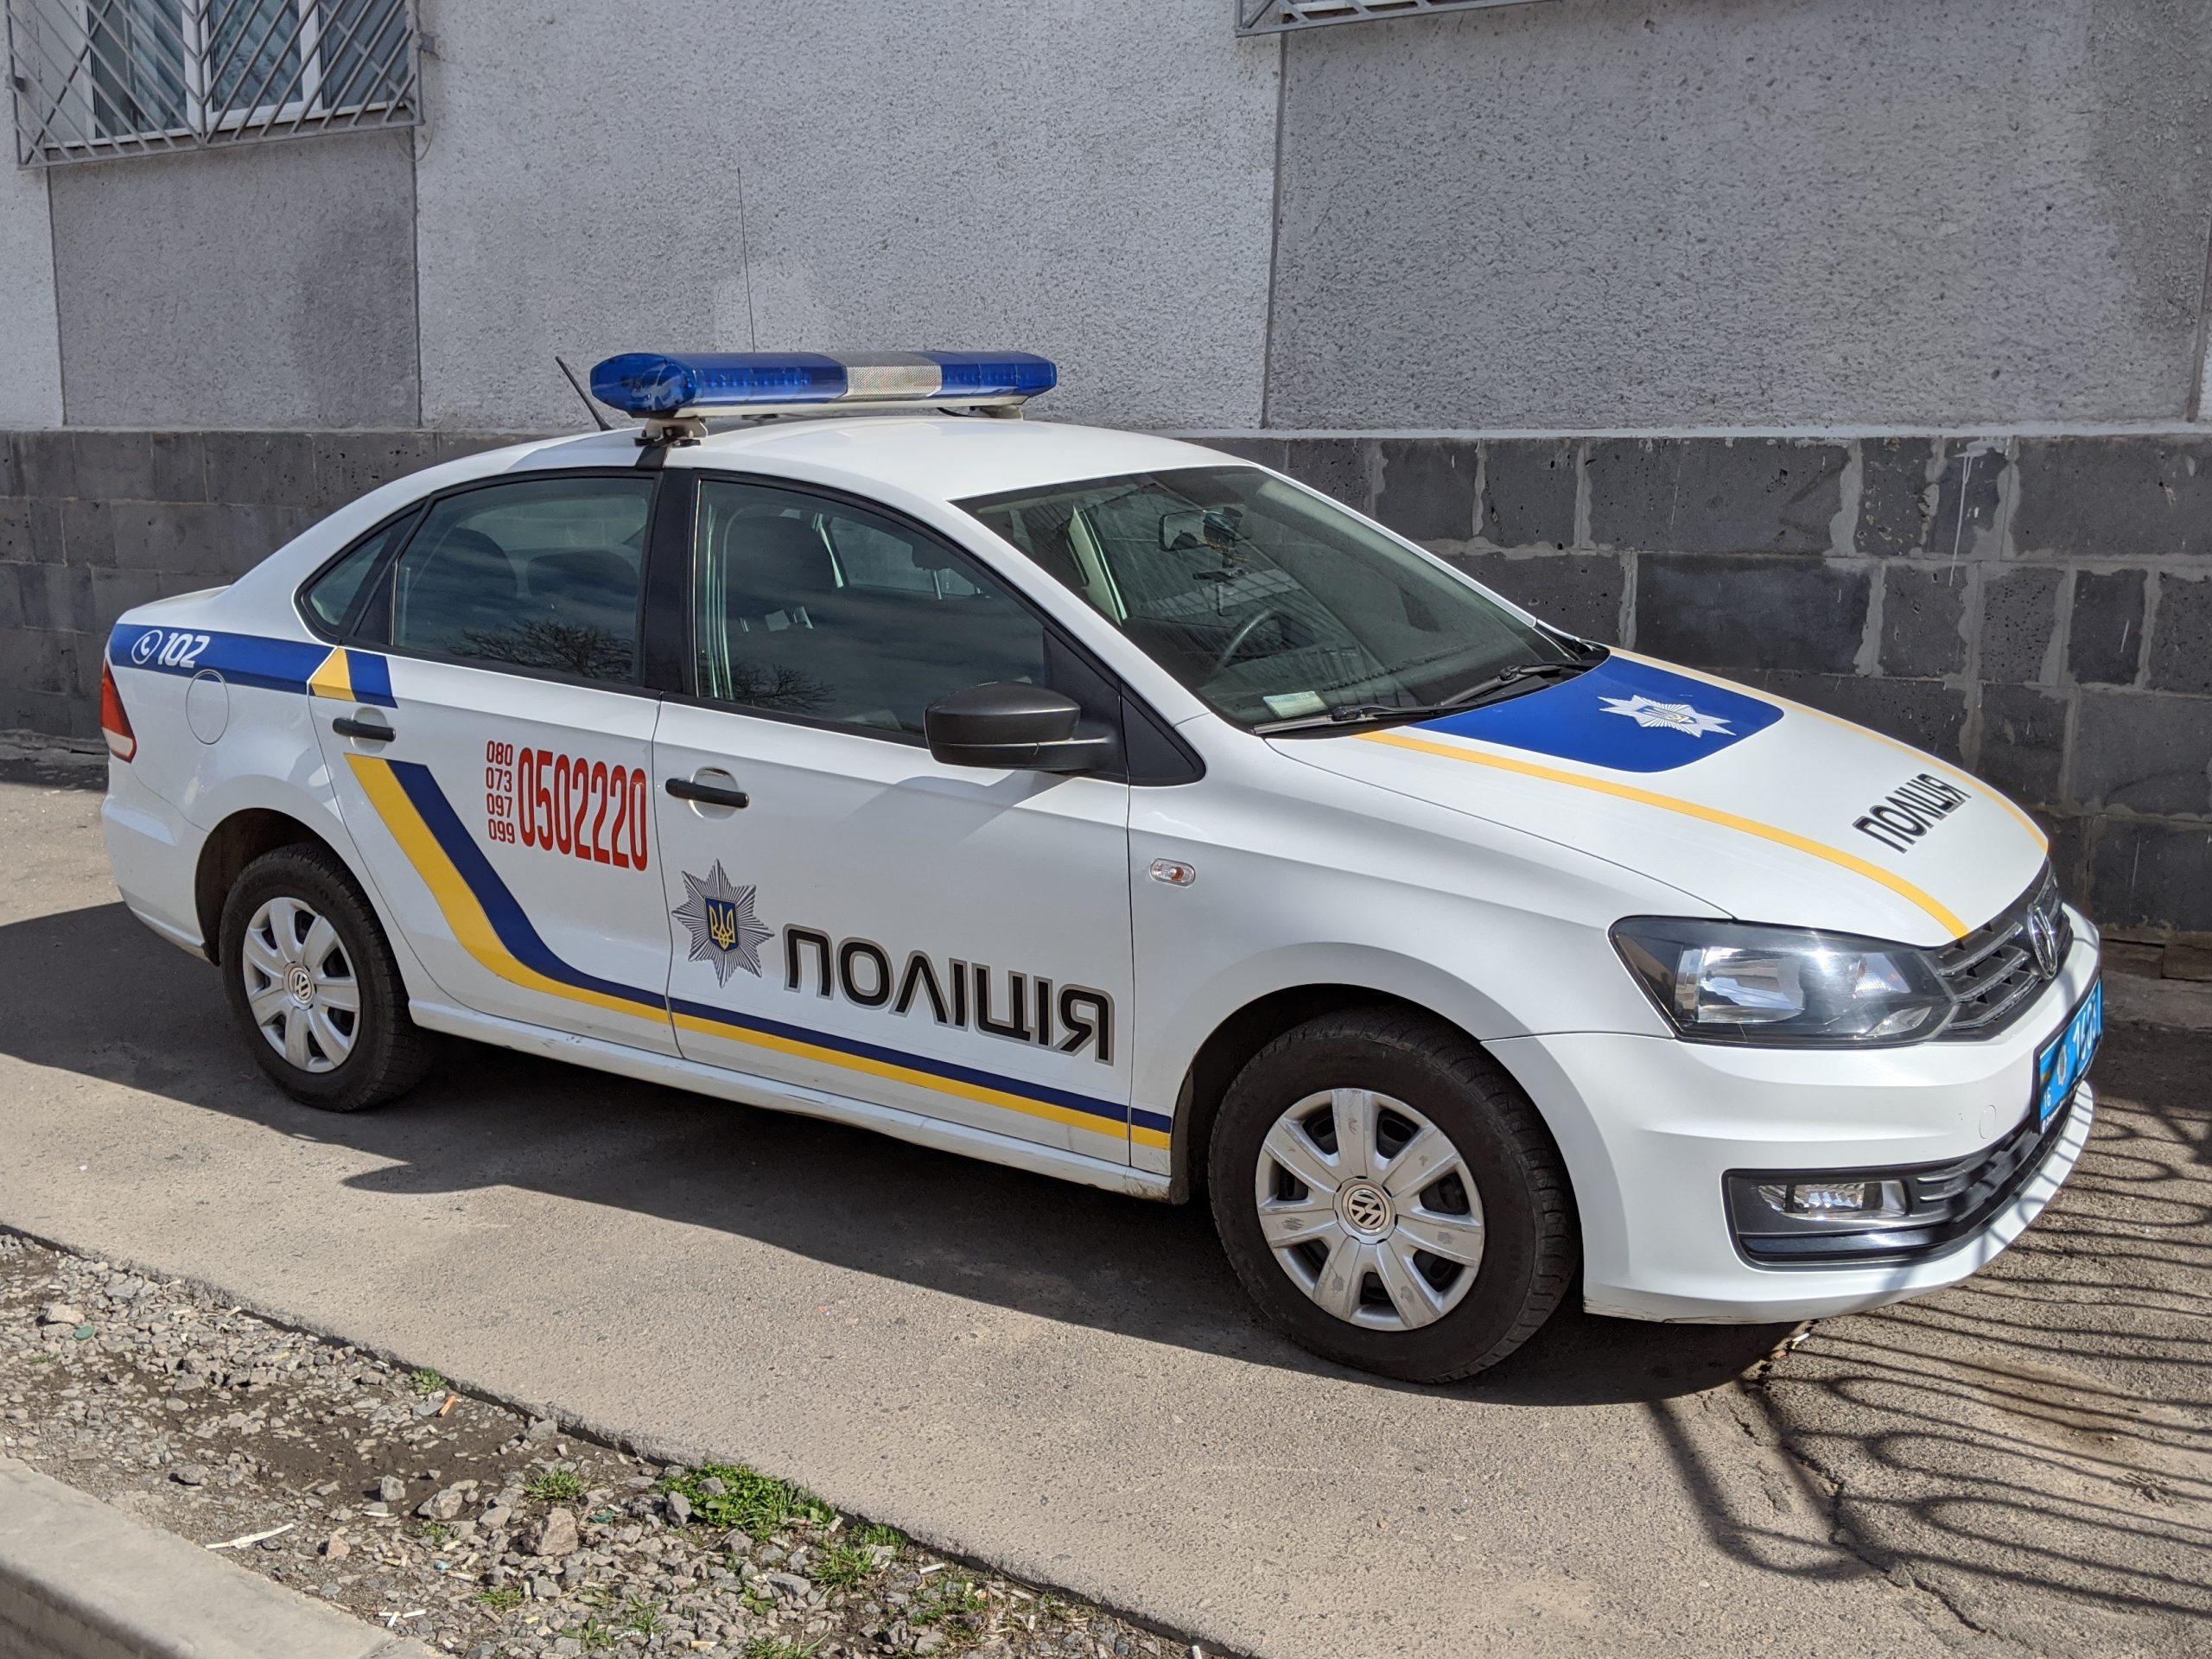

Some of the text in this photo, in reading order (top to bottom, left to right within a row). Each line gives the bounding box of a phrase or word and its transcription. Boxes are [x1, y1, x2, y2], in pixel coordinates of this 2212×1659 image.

[157, 632, 211, 668] 102
[486, 740, 514, 766] 080
[486, 766, 512, 792] 073
[486, 792, 513, 818] 097
[518, 747, 647, 871] 0502220
[1852, 773, 1972, 854] ПОЛІЦІЯ
[487, 818, 516, 844] 099
[783, 924, 1115, 1066] ПОЛІЦІЯ
